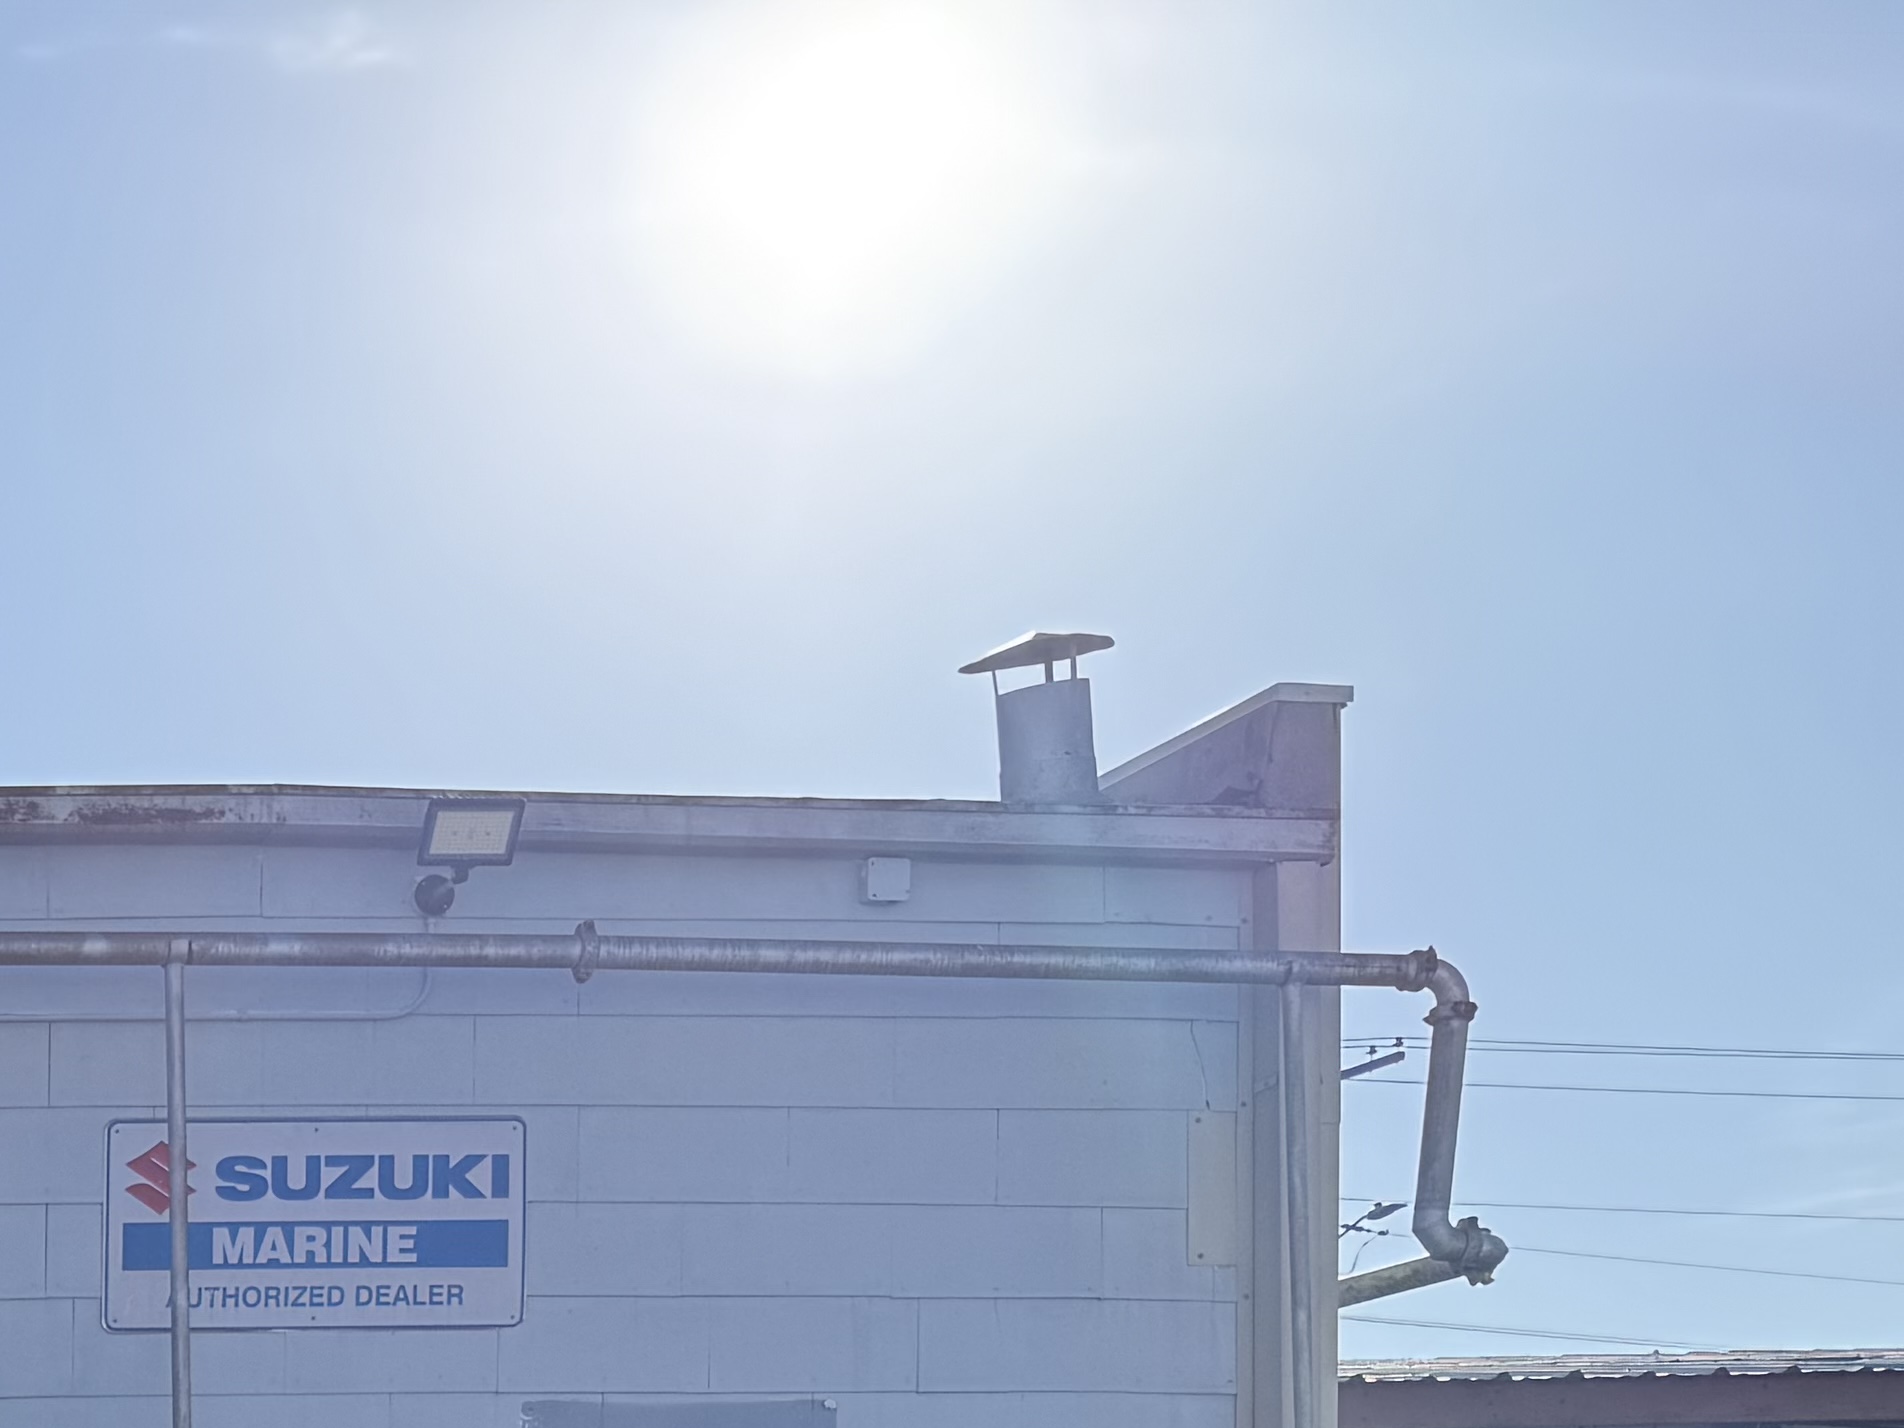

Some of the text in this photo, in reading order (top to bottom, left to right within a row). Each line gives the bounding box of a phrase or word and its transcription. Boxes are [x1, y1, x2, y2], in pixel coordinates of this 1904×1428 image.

[214, 1153, 510, 1202] SUZUKI
[211, 1225, 418, 1266] MARINE
[354, 1284, 464, 1307] DEALER
